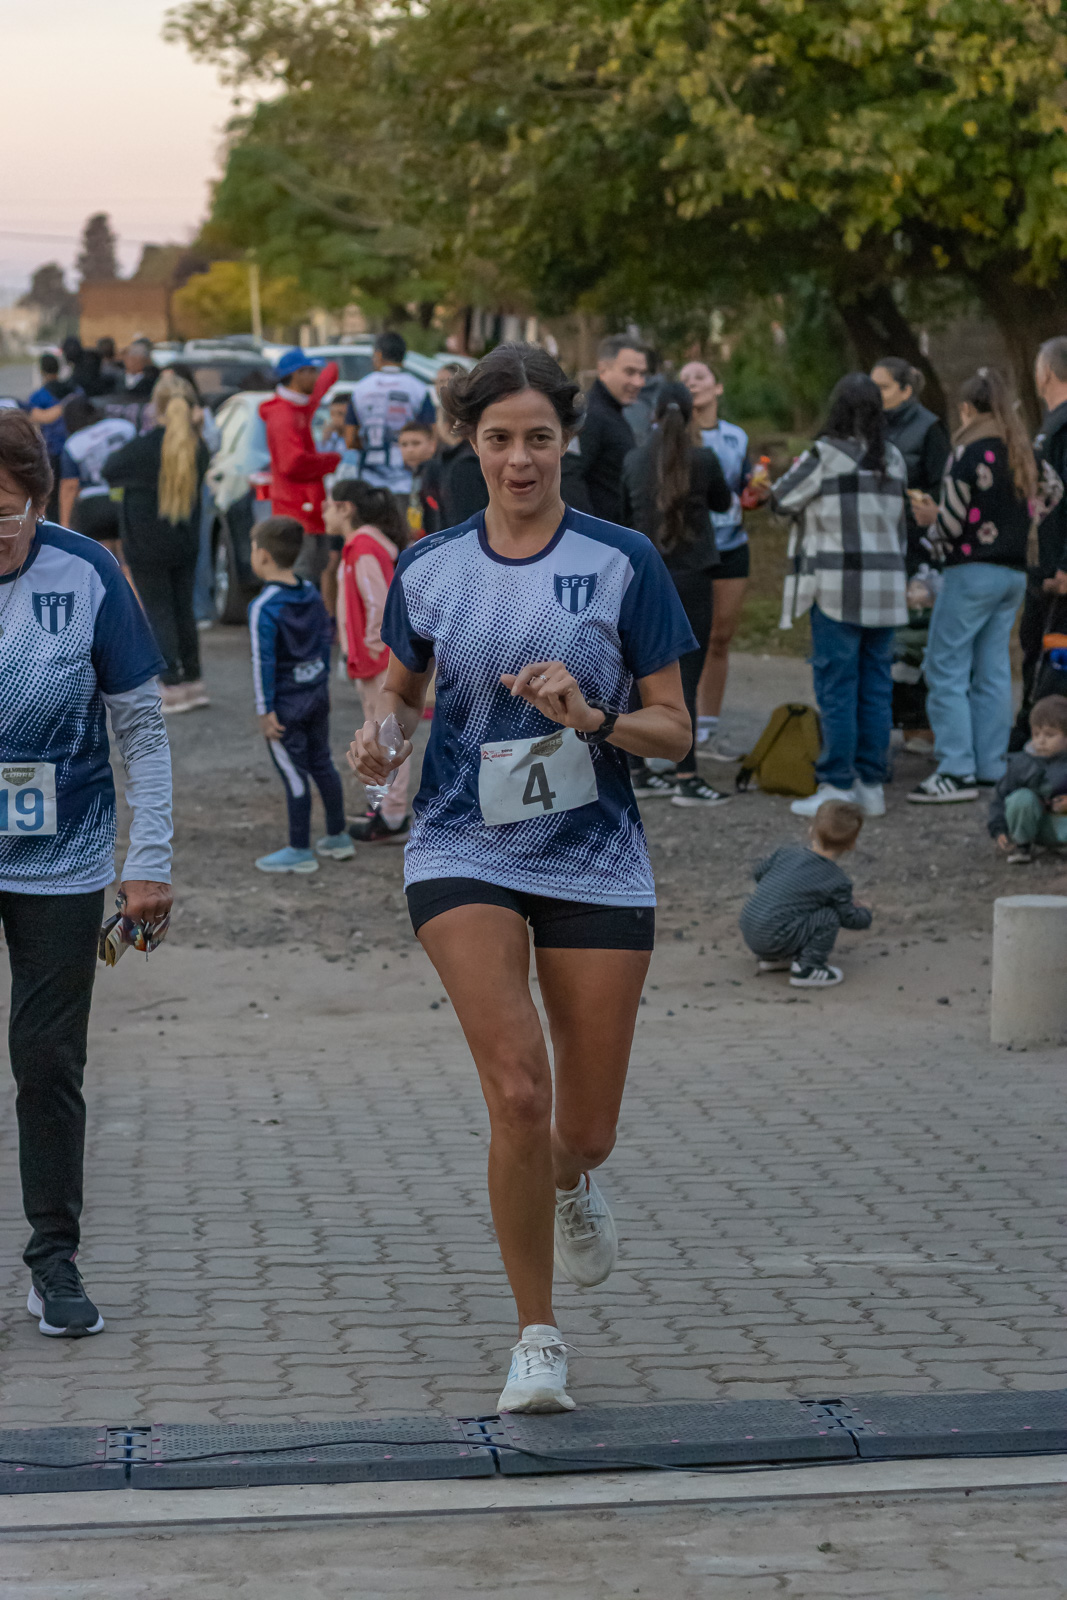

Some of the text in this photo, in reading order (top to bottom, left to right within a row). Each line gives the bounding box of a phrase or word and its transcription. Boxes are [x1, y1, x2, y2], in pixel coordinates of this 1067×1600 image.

[561, 577, 590, 587] SFC
[39, 595, 68, 606] SFC
[522, 762, 556, 811] 4
